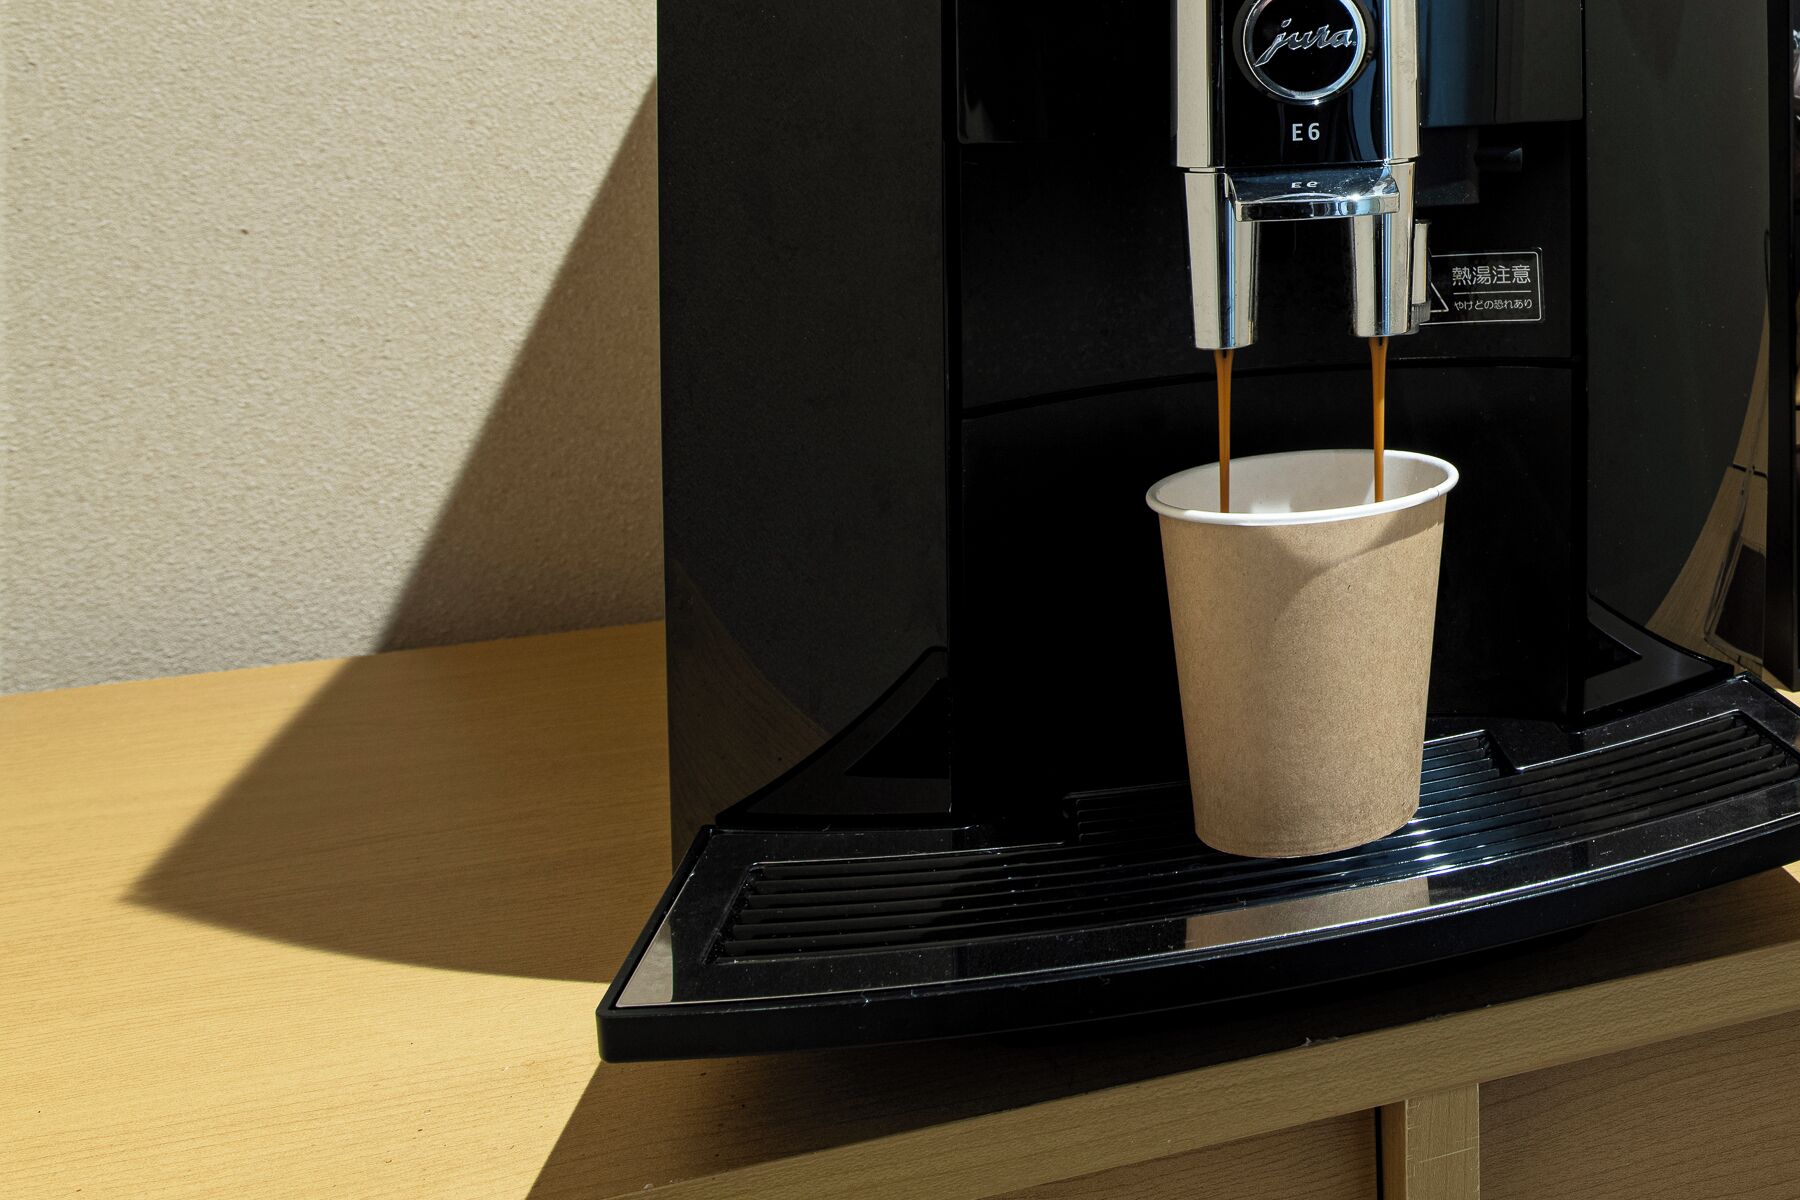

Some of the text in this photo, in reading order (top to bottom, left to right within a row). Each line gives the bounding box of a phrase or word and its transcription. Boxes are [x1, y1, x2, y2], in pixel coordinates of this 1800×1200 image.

[1253, 17, 1354, 68] jura
[1451, 264, 1531, 286] 熱湯注意
[1453, 298, 1533, 311] やけどの恐れあり
